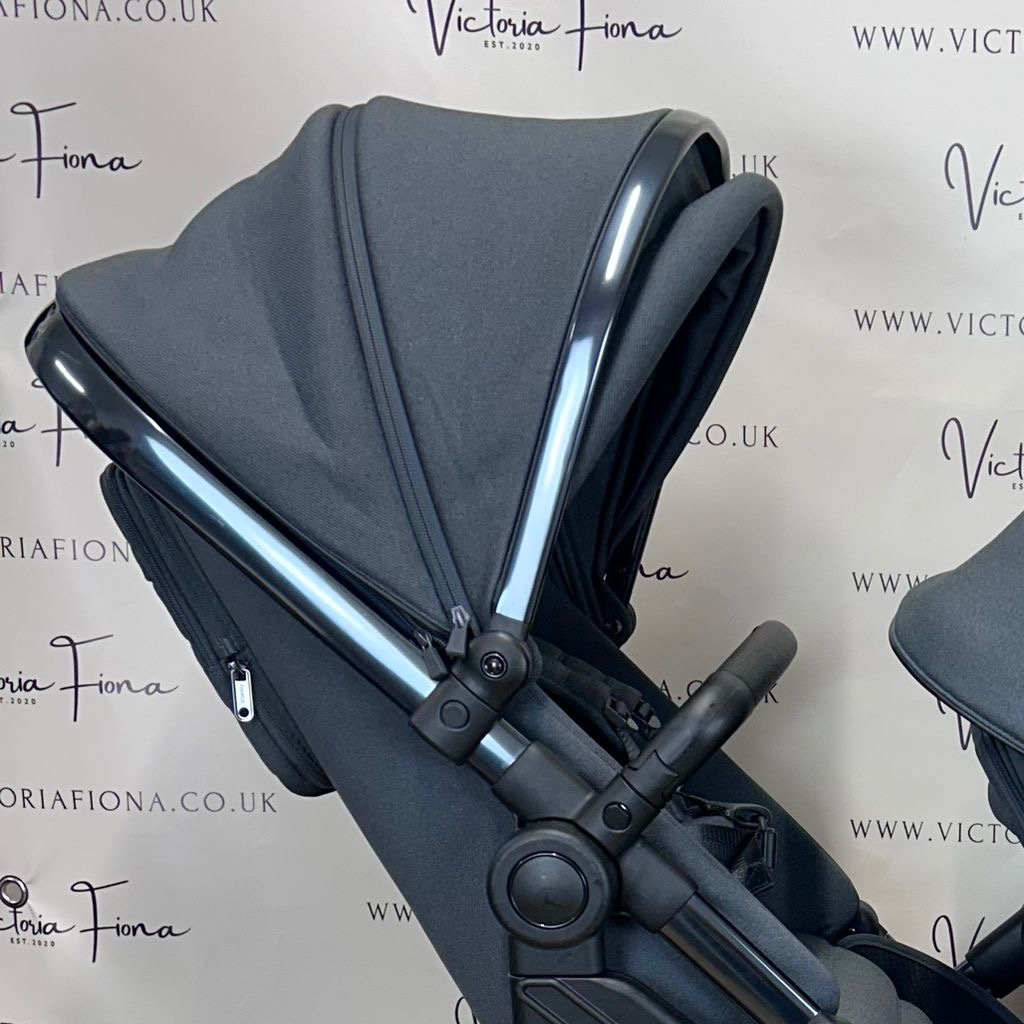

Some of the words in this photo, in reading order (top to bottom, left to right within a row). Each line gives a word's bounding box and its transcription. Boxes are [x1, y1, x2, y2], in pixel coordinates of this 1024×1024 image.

[410, 0, 560, 56] Victoria
[484, 40, 541, 51] EST.2020
[11, 102, 142, 198] Fiona
[50, 634, 179, 722] Fiona
[10, 937, 56, 947] EST.2020
[71, 880, 191, 963] Fiona
